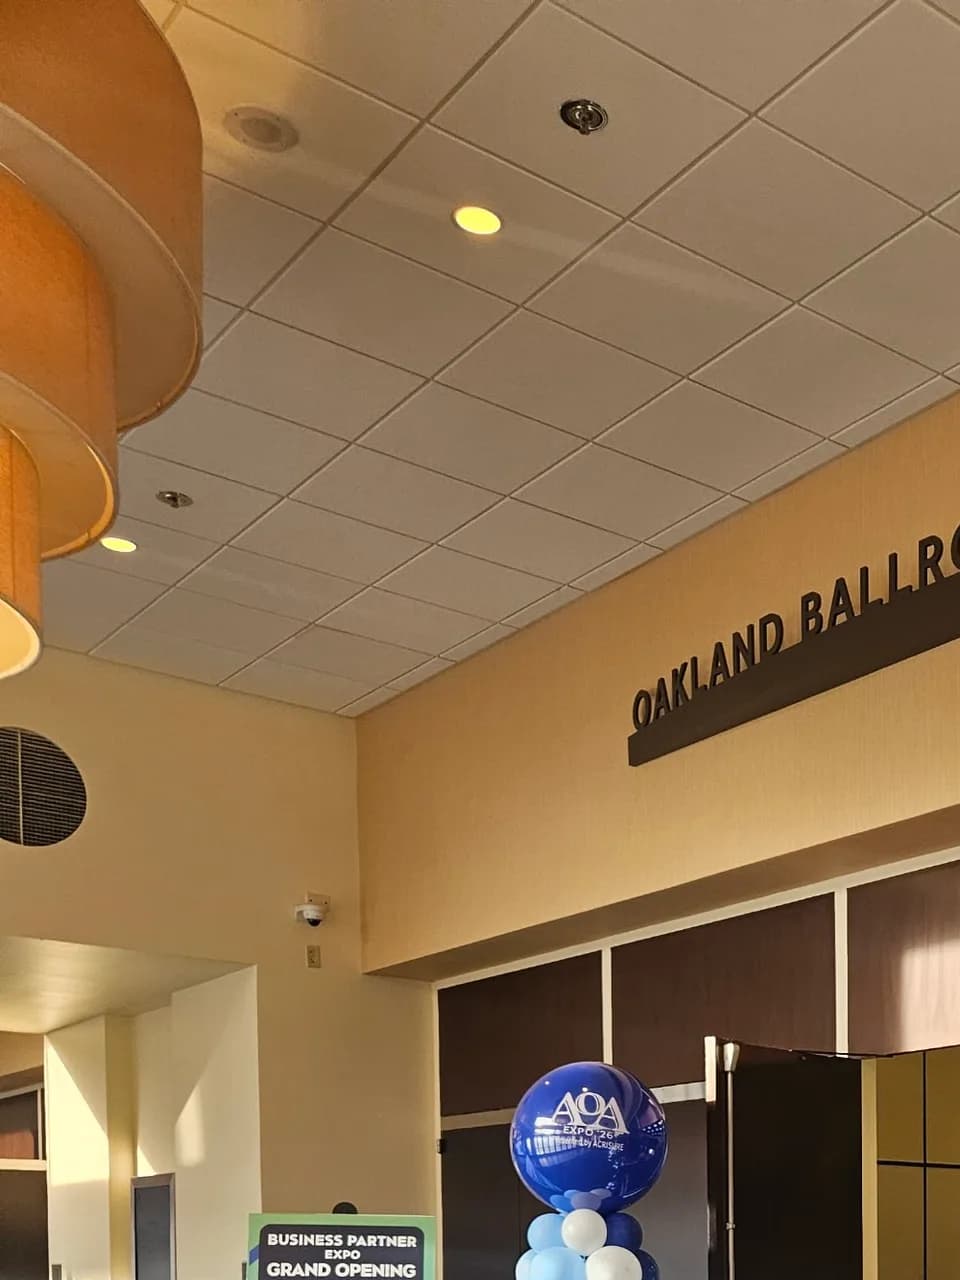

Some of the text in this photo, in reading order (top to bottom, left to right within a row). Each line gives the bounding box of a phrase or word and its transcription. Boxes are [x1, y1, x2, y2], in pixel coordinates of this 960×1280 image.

[631, 612, 784, 731] OAKLAND
[552, 1091, 630, 1135] AOA
[563, 1125, 594, 1137] EXPO
[267, 1234, 417, 1248] BUSINESS PARTNER
[324, 1250, 361, 1260] EXPO
[266, 1263, 417, 1278] GRAND OPENING
